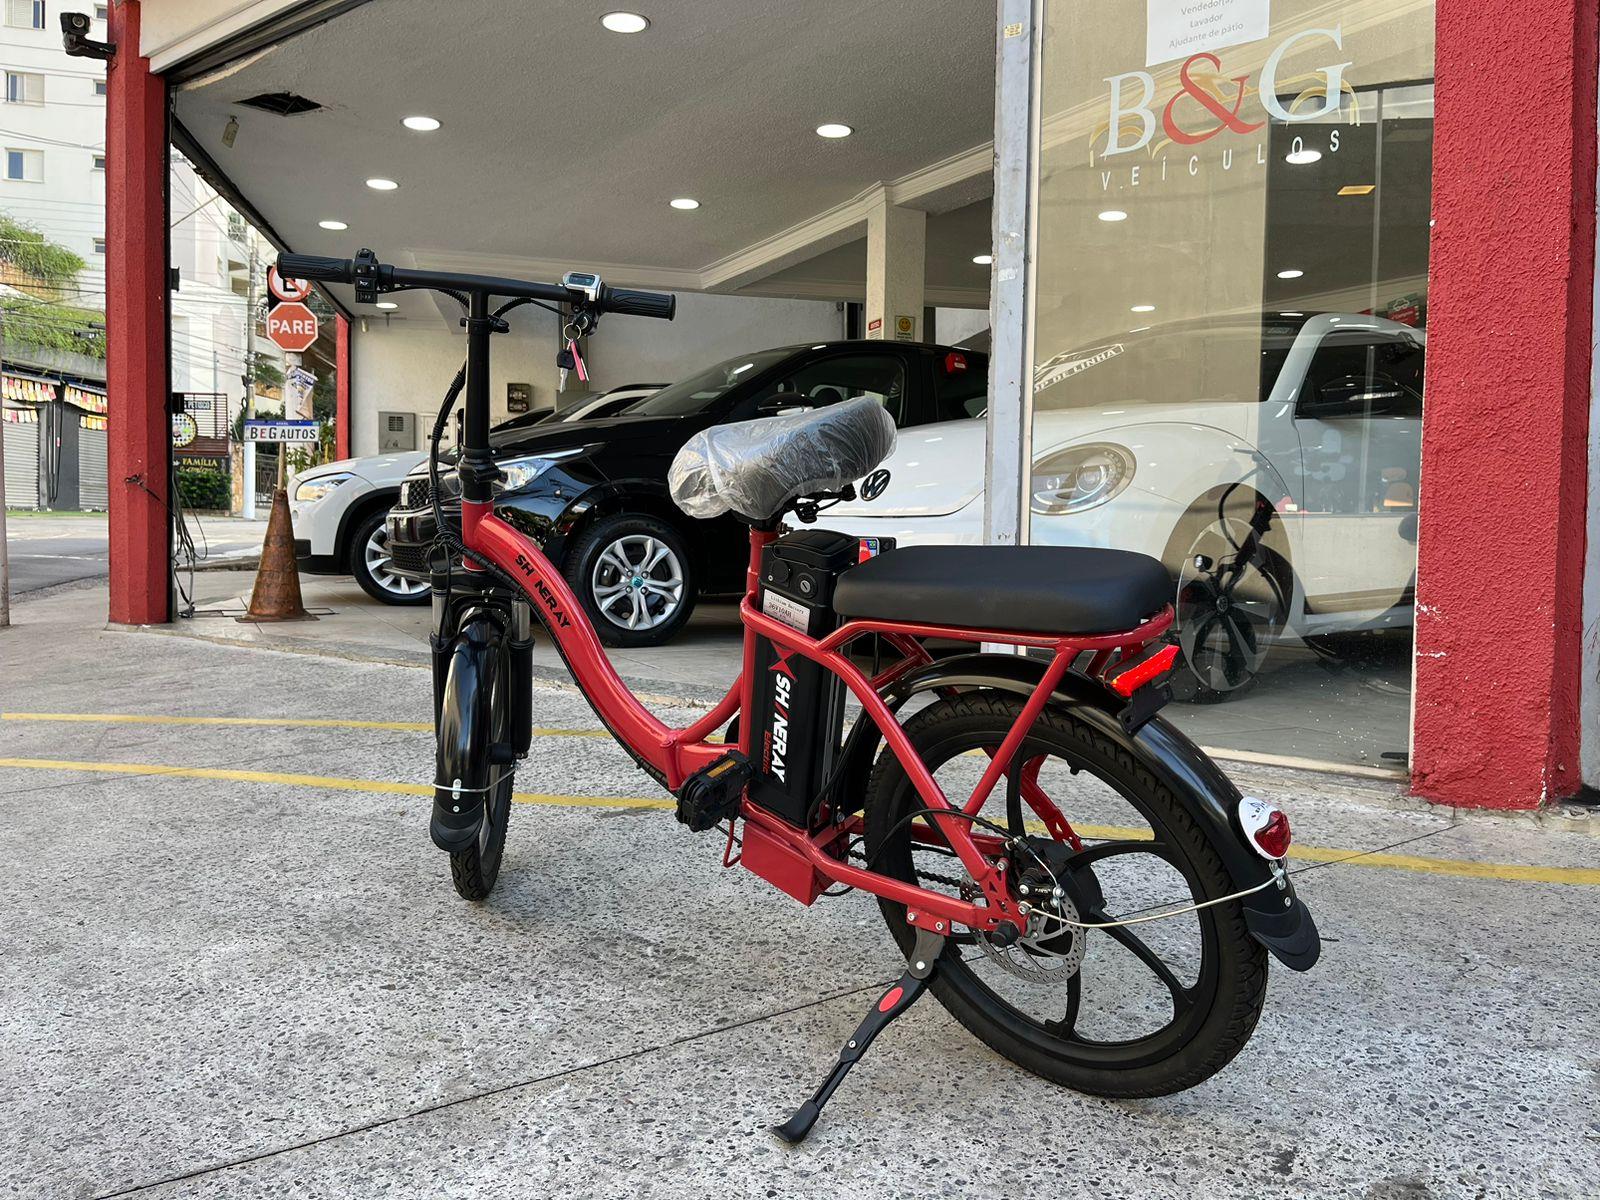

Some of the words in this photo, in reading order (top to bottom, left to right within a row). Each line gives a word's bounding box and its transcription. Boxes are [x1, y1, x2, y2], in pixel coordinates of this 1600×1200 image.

[1189, 13, 1223, 28] Lavador
[1168, 32, 1206, 49] Ajudante
[1208, 28, 1220, 38] de
[1100, 23, 1353, 158] B&G
[270, 320, 315, 335] PARE
[1053, 371, 1070, 382] DE
[1073, 349, 1117, 373] LINHA
[280, 429, 316, 439] AUTOS
